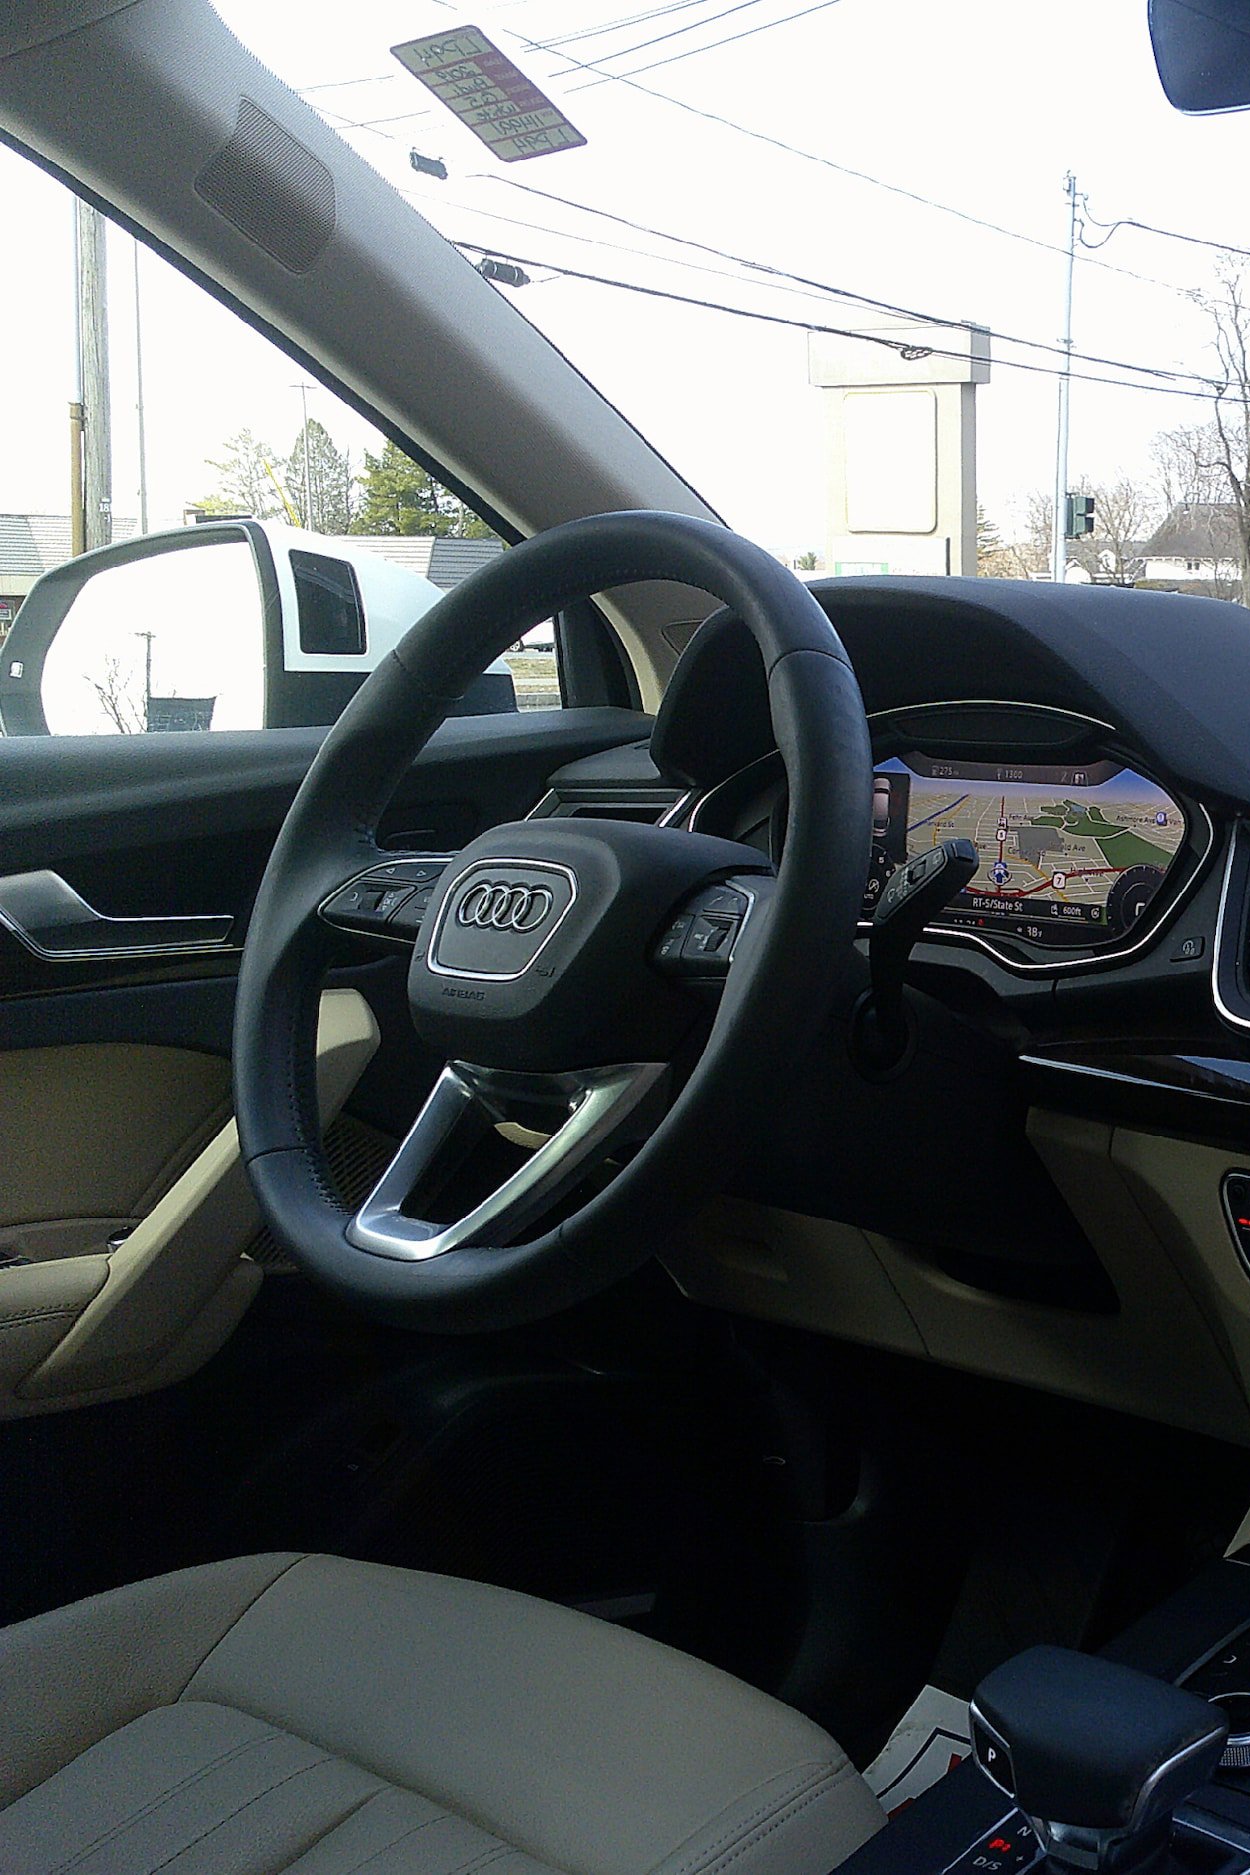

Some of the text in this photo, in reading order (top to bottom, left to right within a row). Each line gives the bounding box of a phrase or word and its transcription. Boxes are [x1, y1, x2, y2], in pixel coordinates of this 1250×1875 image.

[1005, 769, 1023, 779] 1300
[1014, 902, 1024, 912] St
[988, 1747, 997, 1764] P
[1017, 1826, 1032, 1837] N
[972, 1855, 1003, 1871] D/S
